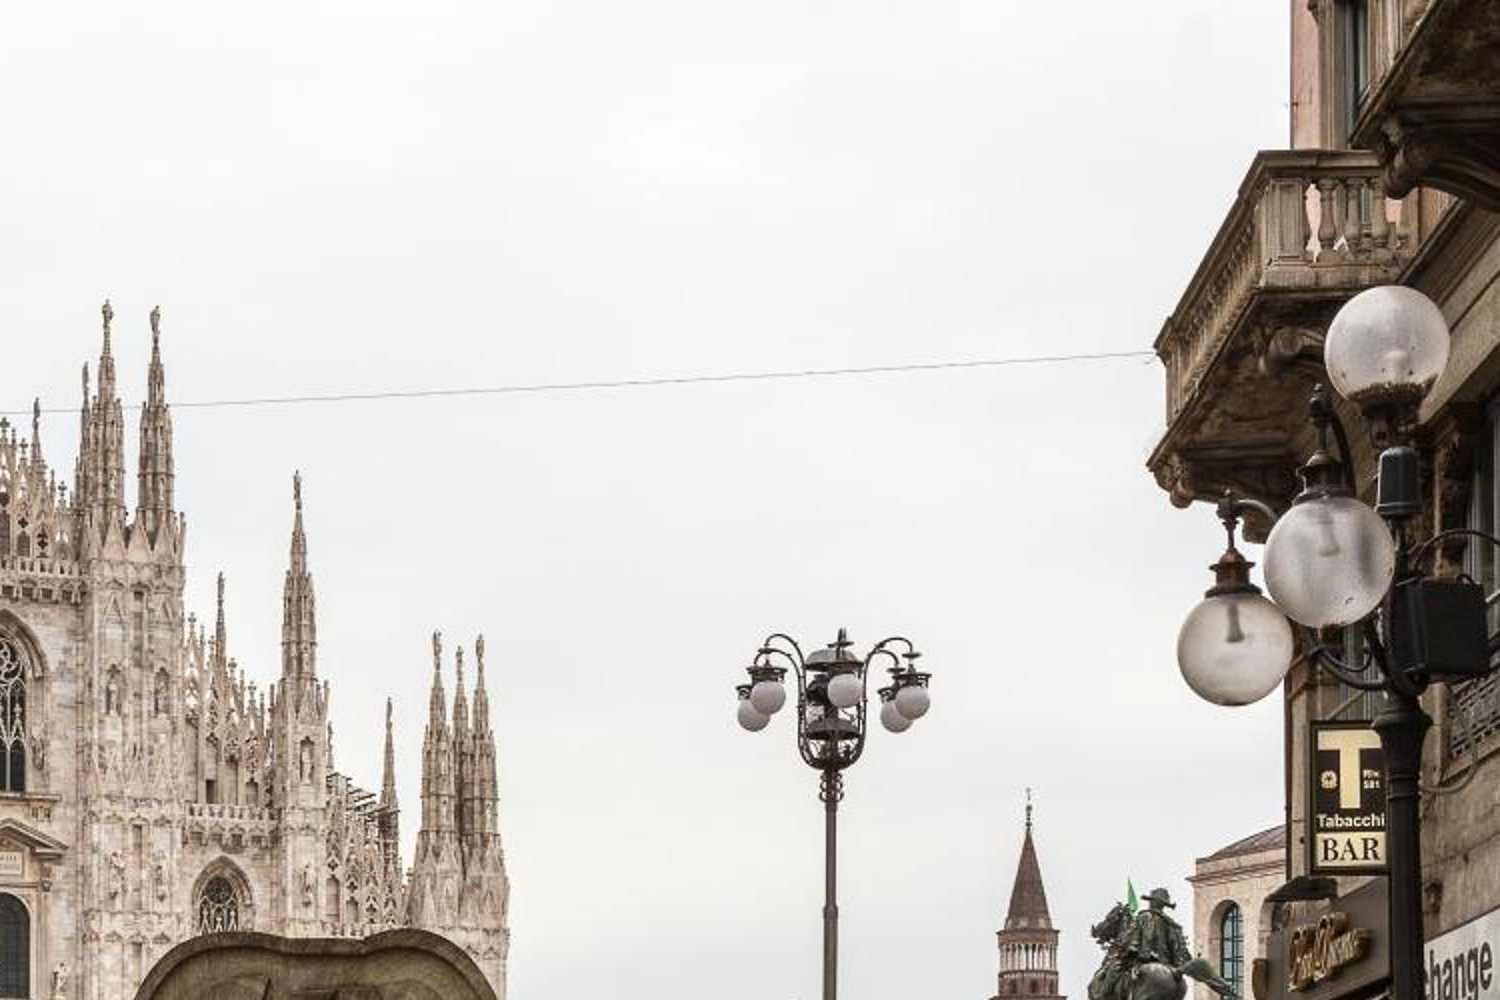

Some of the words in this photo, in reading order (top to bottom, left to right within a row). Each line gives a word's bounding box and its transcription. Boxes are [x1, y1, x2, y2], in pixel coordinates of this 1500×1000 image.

[1317, 730, 1382, 809] T
[1317, 813, 1386, 829] Tabacchi
[1321, 837, 1381, 862] BAR
